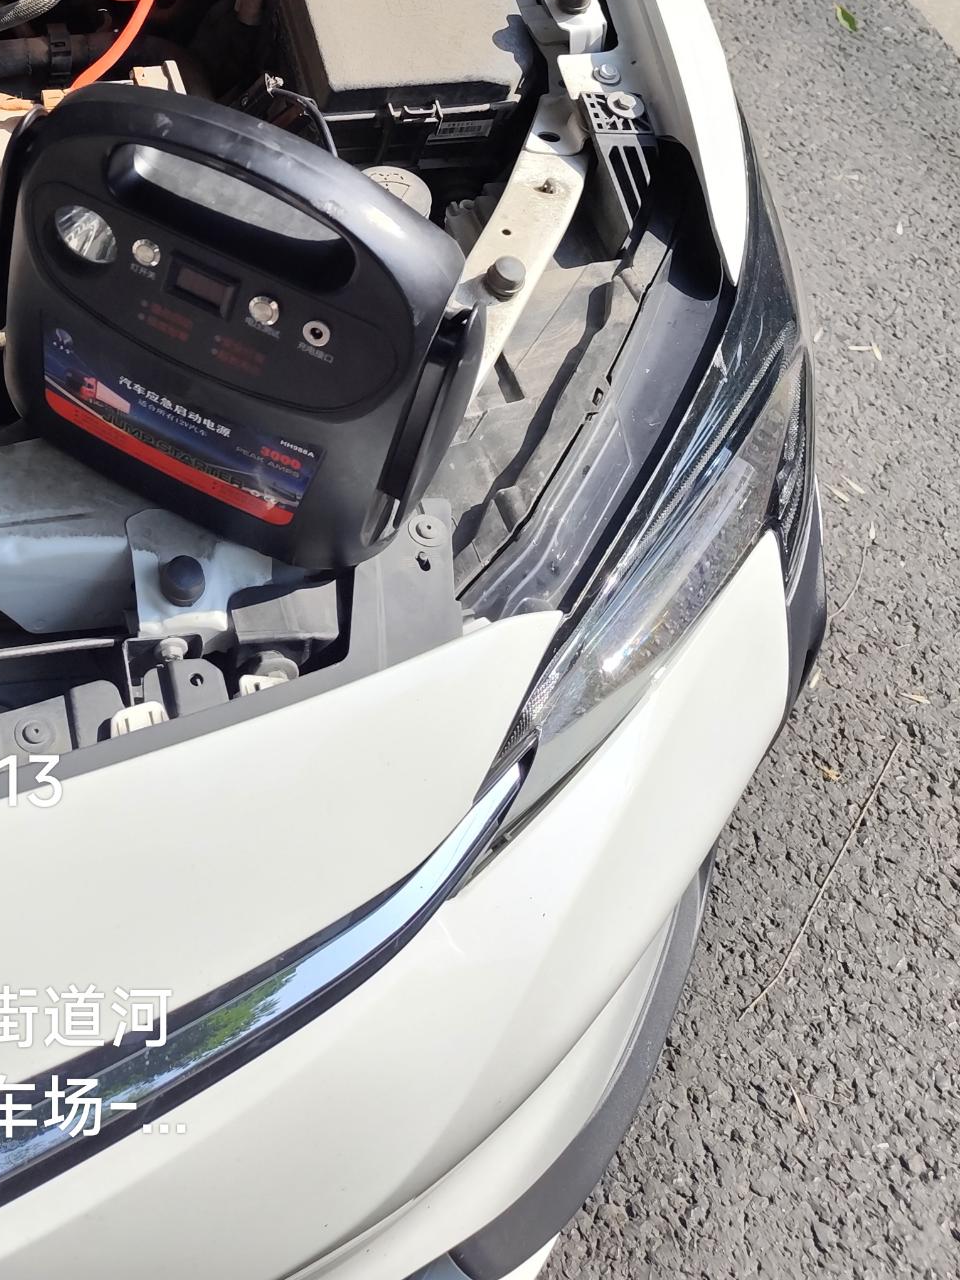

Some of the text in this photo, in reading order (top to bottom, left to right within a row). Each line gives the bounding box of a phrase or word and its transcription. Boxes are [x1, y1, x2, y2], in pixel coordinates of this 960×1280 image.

[118, 375, 232, 438] 汽车应急启动电源
